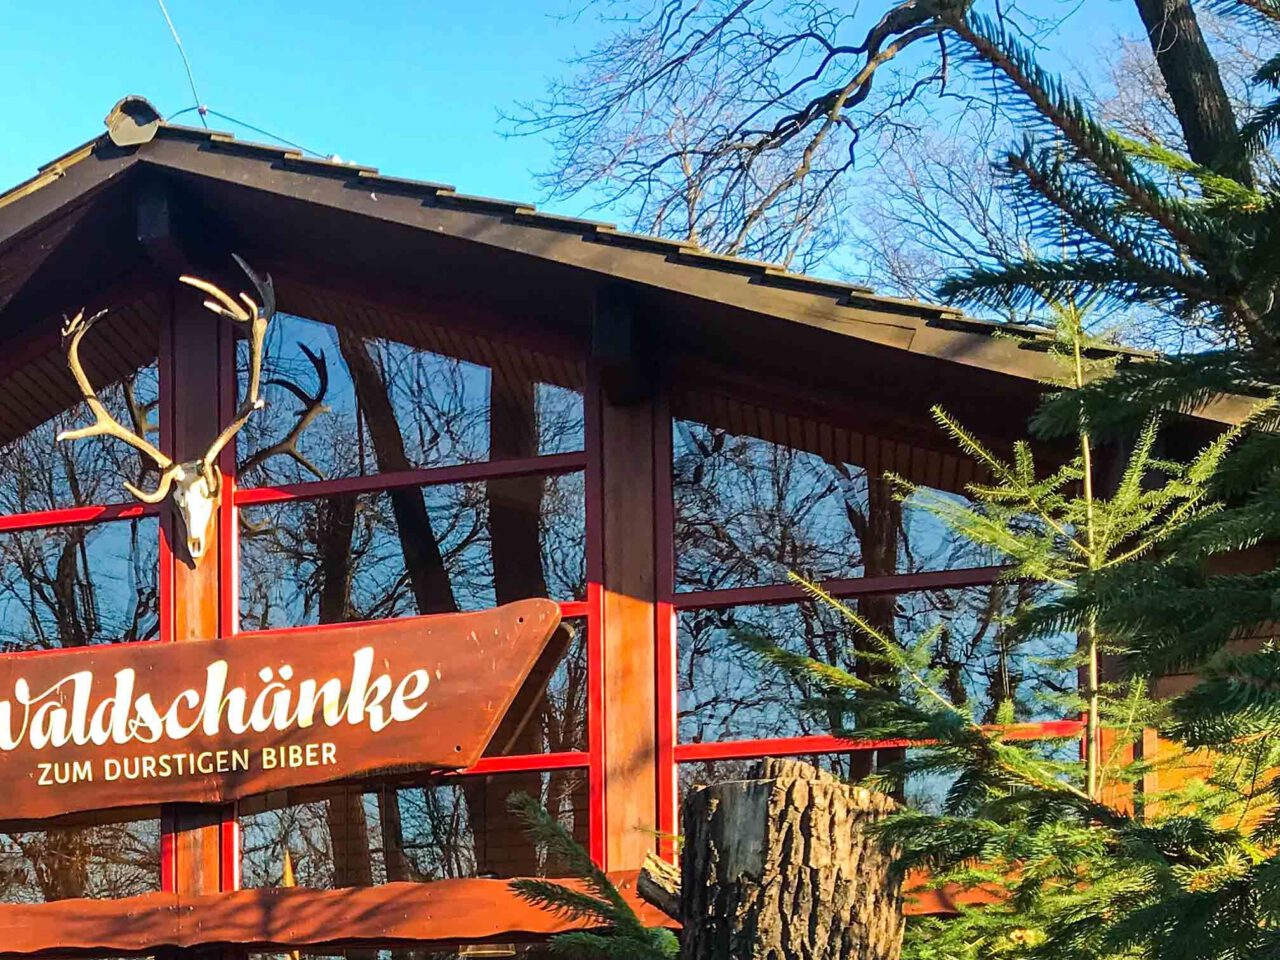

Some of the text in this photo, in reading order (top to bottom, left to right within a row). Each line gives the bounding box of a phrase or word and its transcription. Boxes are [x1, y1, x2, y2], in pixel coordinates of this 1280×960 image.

[36, 742, 338, 786] ZUM DURSTIGEN BIBER
